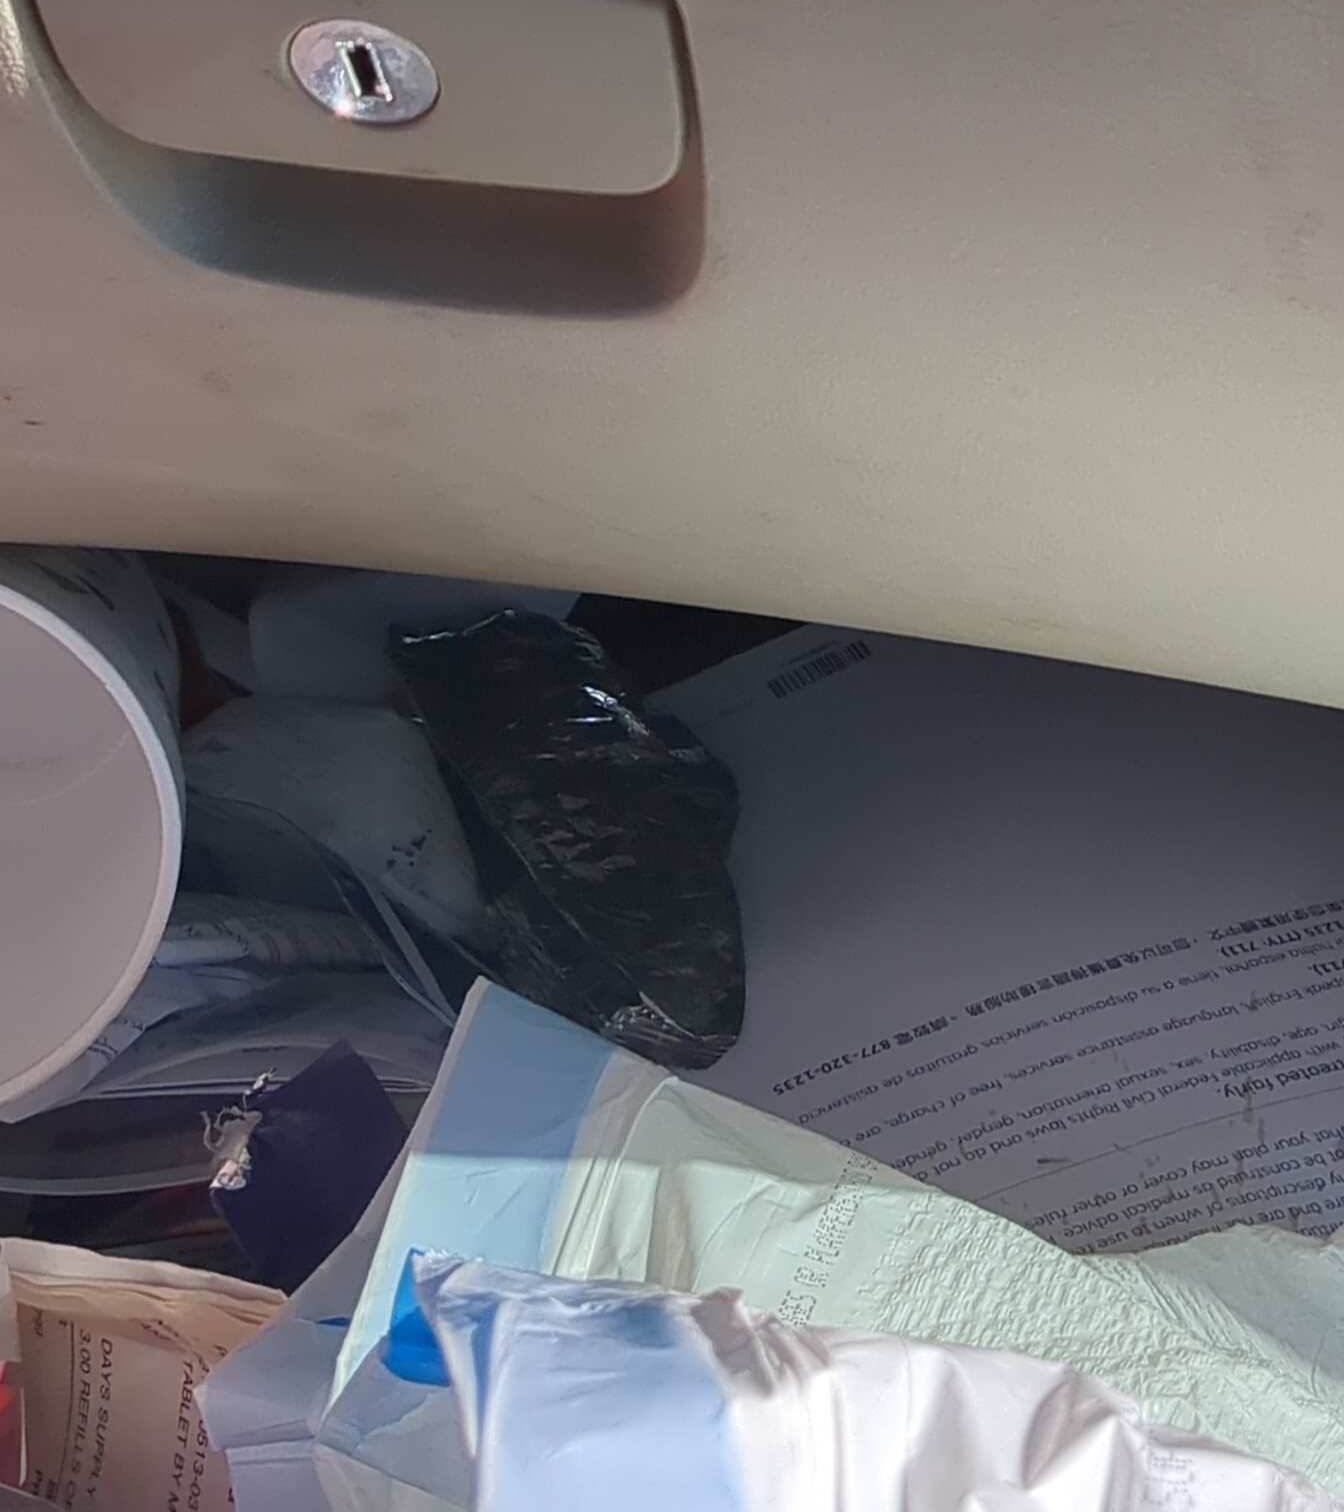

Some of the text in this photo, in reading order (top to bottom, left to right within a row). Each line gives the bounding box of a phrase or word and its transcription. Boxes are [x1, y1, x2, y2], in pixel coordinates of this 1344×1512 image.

[1215, 938, 1261, 961] 711).
[1140, 983, 1161, 997] su
[1162, 979, 1175, 990] a
[1177, 968, 1220, 989] tiene
[1050, 987, 1139, 1027] disposición
[1161, 1000, 1240, 1035] language
[979, 1017, 1050, 1051] servicios
[1075, 1025, 1161, 1060] assistance
[1281, 1023, 1320, 1042] age,
[904, 1039, 979, 1082] gratuitos
[1304, 1040, 1341, 1059] with
[771, 1037, 891, 1097] 877-320-1235
[1002, 1050, 1073, 1085] services,
[1219, 1047, 1303, 1081] applicable
[881, 1072, 904, 1091] de
[968, 1075, 1002, 1099] free
[1114, 1065, 1168, 1091] sexual
[1156, 1071, 1219, 1099] Federal
[1215, 1072, 1275, 1101] fairly.
[797, 1082, 880, 1125] asistencia
[948, 1090, 967, 1107] of
[1015, 1080, 1112, 1123] orientation,
[1120, 1089, 1156, 1110] Civil
[882, 1095, 946, 1132] charge,
[1065, 1097, 1121, 1127] Rights
[853, 1123, 881, 1142] are
[1023, 1117, 1067, 1141] laws
[1271, 1130, 1311, 1150] your
[963, 1145, 988, 1165] do
[988, 1131, 1024, 1155] and
[1230, 1140, 1270, 1163] plan
[932, 1155, 962, 1176] not
[1189, 1150, 1229, 1172] may
[1302, 1152, 1326, 1168] be
[1141, 1165, 1188, 1188] cover
[1215, 1158, 1302, 1190] construed
[1119, 1182, 1139, 1196] or
[1192, 1180, 1214, 1195] as
[1223, 1174, 1327, 1210] descriptions
[1070, 1189, 1118, 1216] other
[1121, 1188, 1191, 1220] medical
[1205, 1200, 1225, 1216] of
[1287, 1201, 1323, 1218] and
[1058, 1211, 1120, 1242] advice.
[1152, 1206, 1204, 1232] when
[1256, 1208, 1286, 1222] are
[1095, 1230, 1129, 1248] use
[1130, 1222, 1152, 1239] to
[79, 1328, 92, 1375] 3.00
[176, 1359, 193, 1448] TABLET
[70, 1379, 92, 1474] REFILLS
[86, 1338, 113, 1504] DAYS SUPPLY
[173, 1452, 185, 1487] BY
